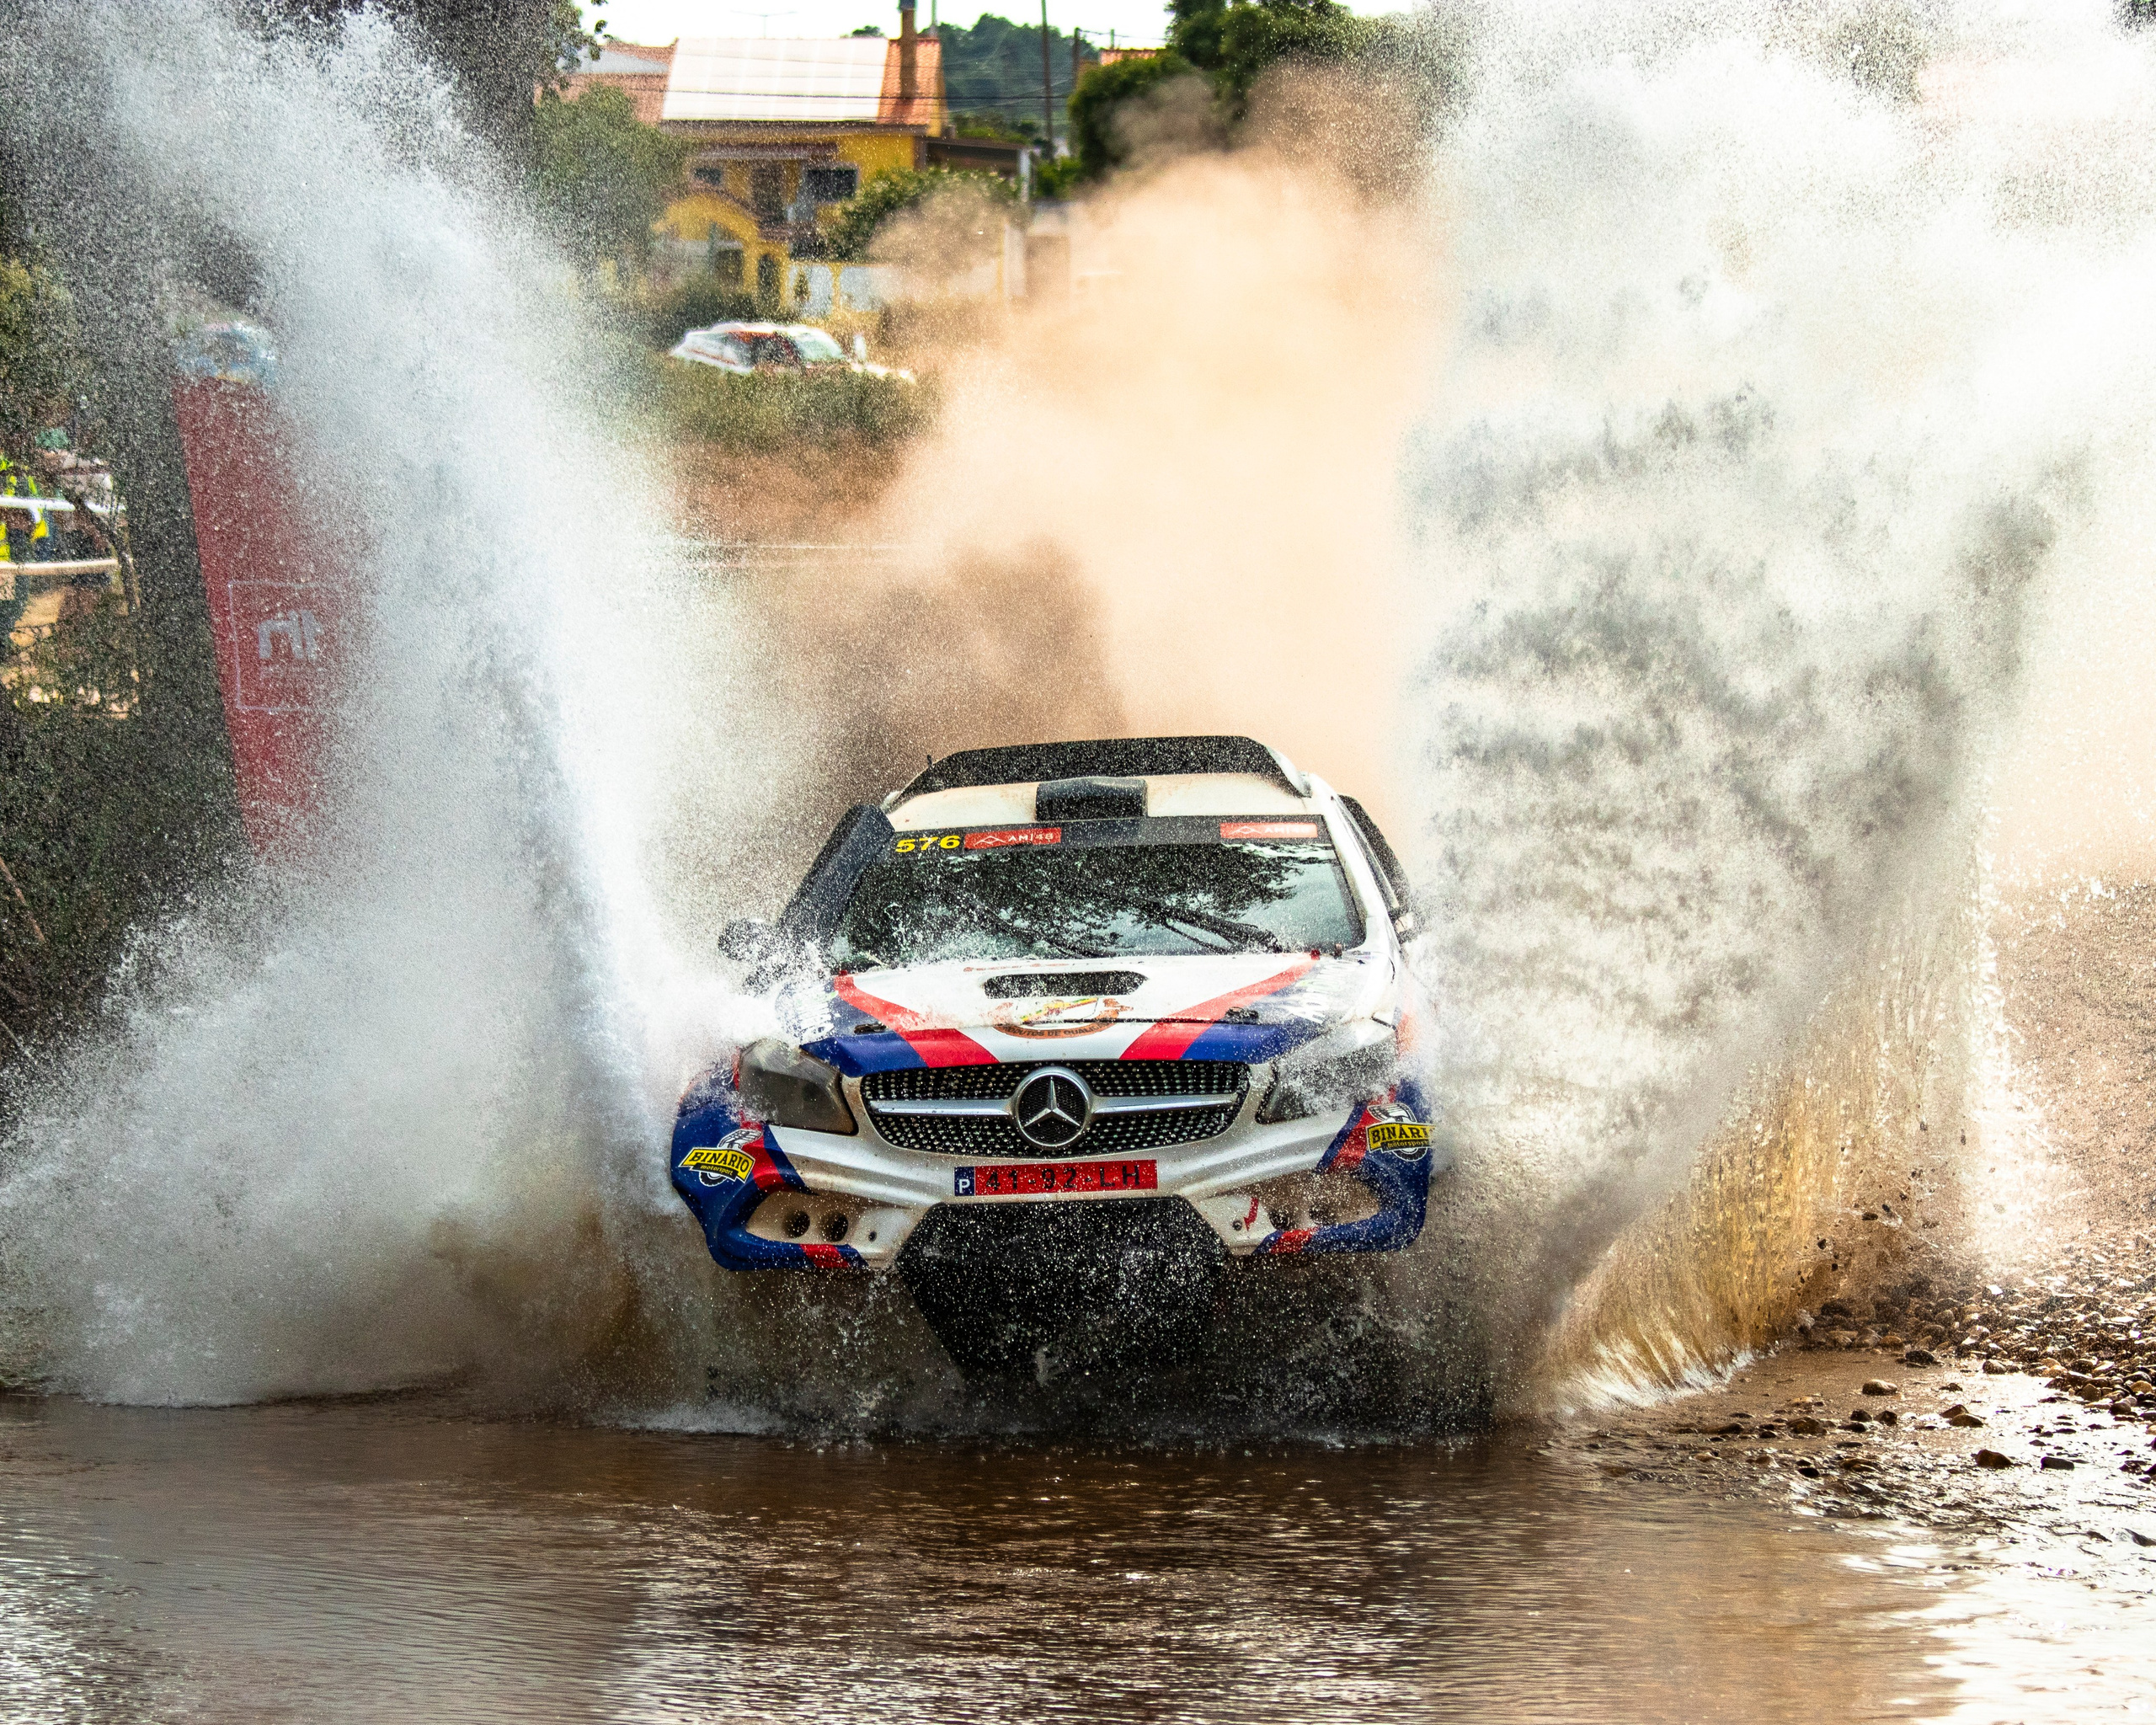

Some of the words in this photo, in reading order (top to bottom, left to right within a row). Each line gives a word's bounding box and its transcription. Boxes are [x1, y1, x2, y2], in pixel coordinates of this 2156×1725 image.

[895, 835, 960, 853] 576
[700, 1165, 734, 1176] motorsport
[958, 1178, 970, 1194] P
[985, 1165, 1140, 1190] 41-92-LH
